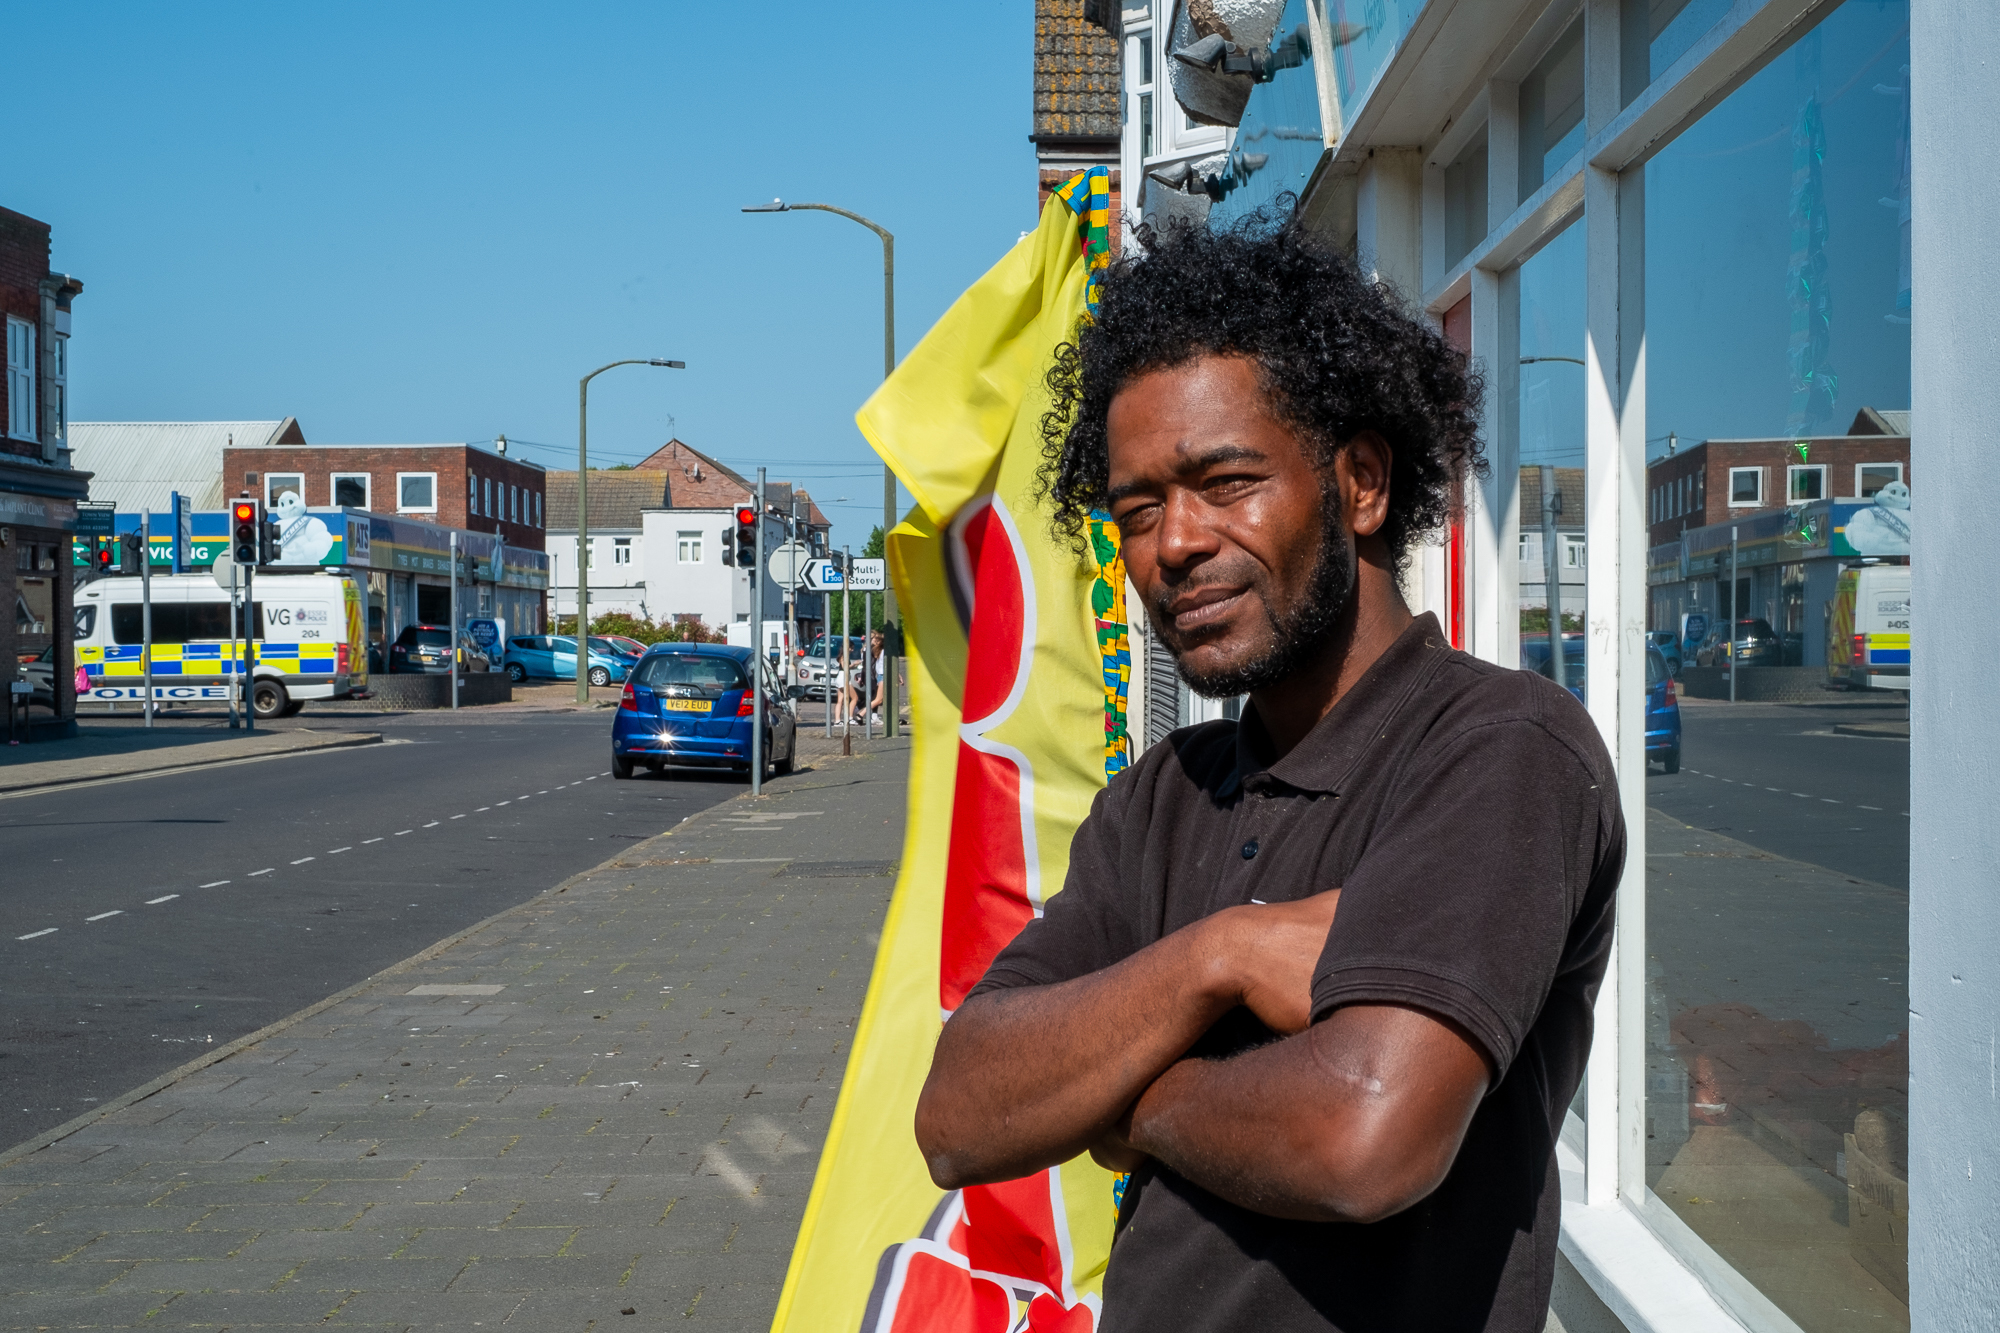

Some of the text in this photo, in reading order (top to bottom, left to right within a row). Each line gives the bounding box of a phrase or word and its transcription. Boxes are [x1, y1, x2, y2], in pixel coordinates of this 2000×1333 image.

[356, 522, 369, 550] ATS
[825, 567, 836, 581] P
[849, 576, 881, 585] Storey
[267, 609, 290, 625] VG
[78, 688, 226, 698] OLICE
[670, 700, 709, 709] VE12 EUD
